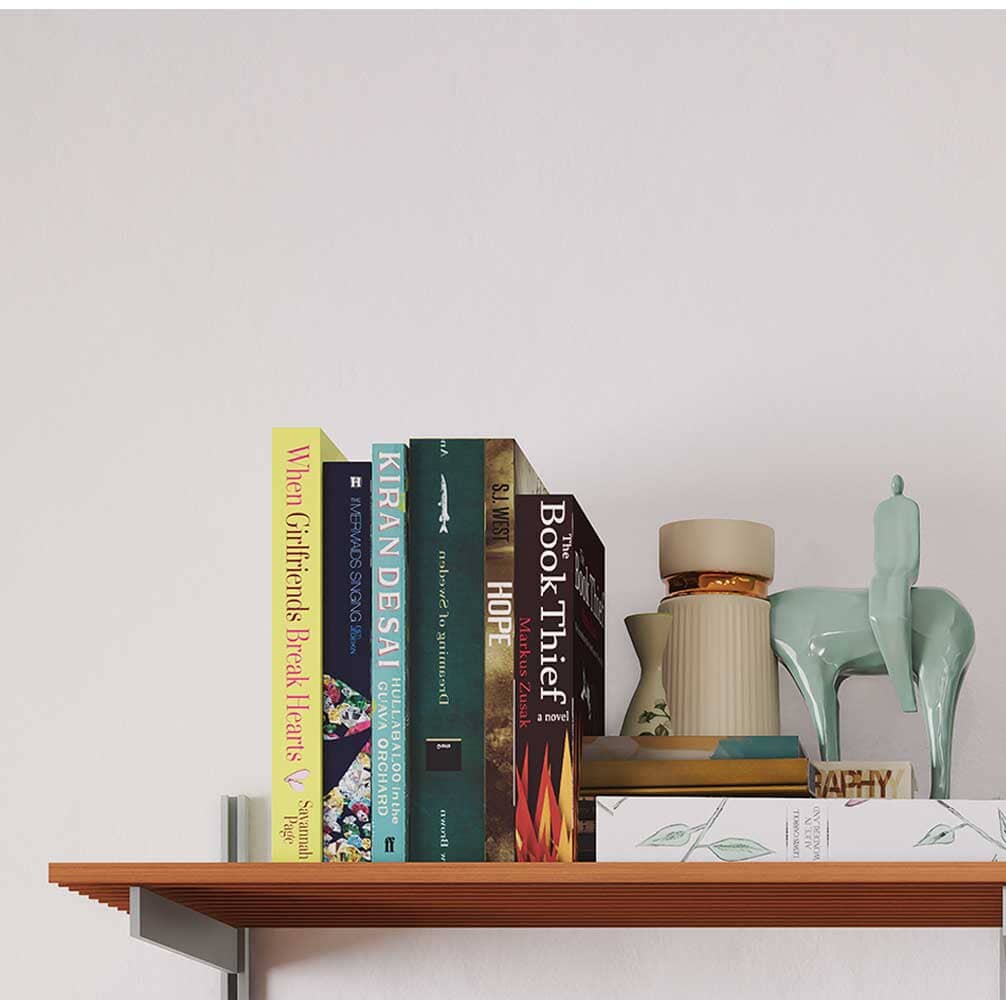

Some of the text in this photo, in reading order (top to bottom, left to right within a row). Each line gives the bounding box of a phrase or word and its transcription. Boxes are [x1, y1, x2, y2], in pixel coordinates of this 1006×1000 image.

[350, 503, 362, 568] MERMAIDS
[490, 483, 511, 543] S.J. WEST
[377, 451, 402, 669] KIRAN DESAI
[562, 533, 572, 560] The
[285, 444, 311, 763] When Girlfriends Break Hearts
[350, 571, 362, 623] SINGING
[486, 580, 514, 648] HOPE
[539, 500, 567, 706] Book Thief
[519, 617, 532, 729] Markus Zusak
[391, 677, 402, 783] HULLABALOO
[537, 710, 570, 722] a novel
[378, 681, 390, 817] GUAVA ORCHARD
[279, 816, 300, 846] Page
[298, 800, 314, 861] Savannah
[391, 802, 402, 825] the
